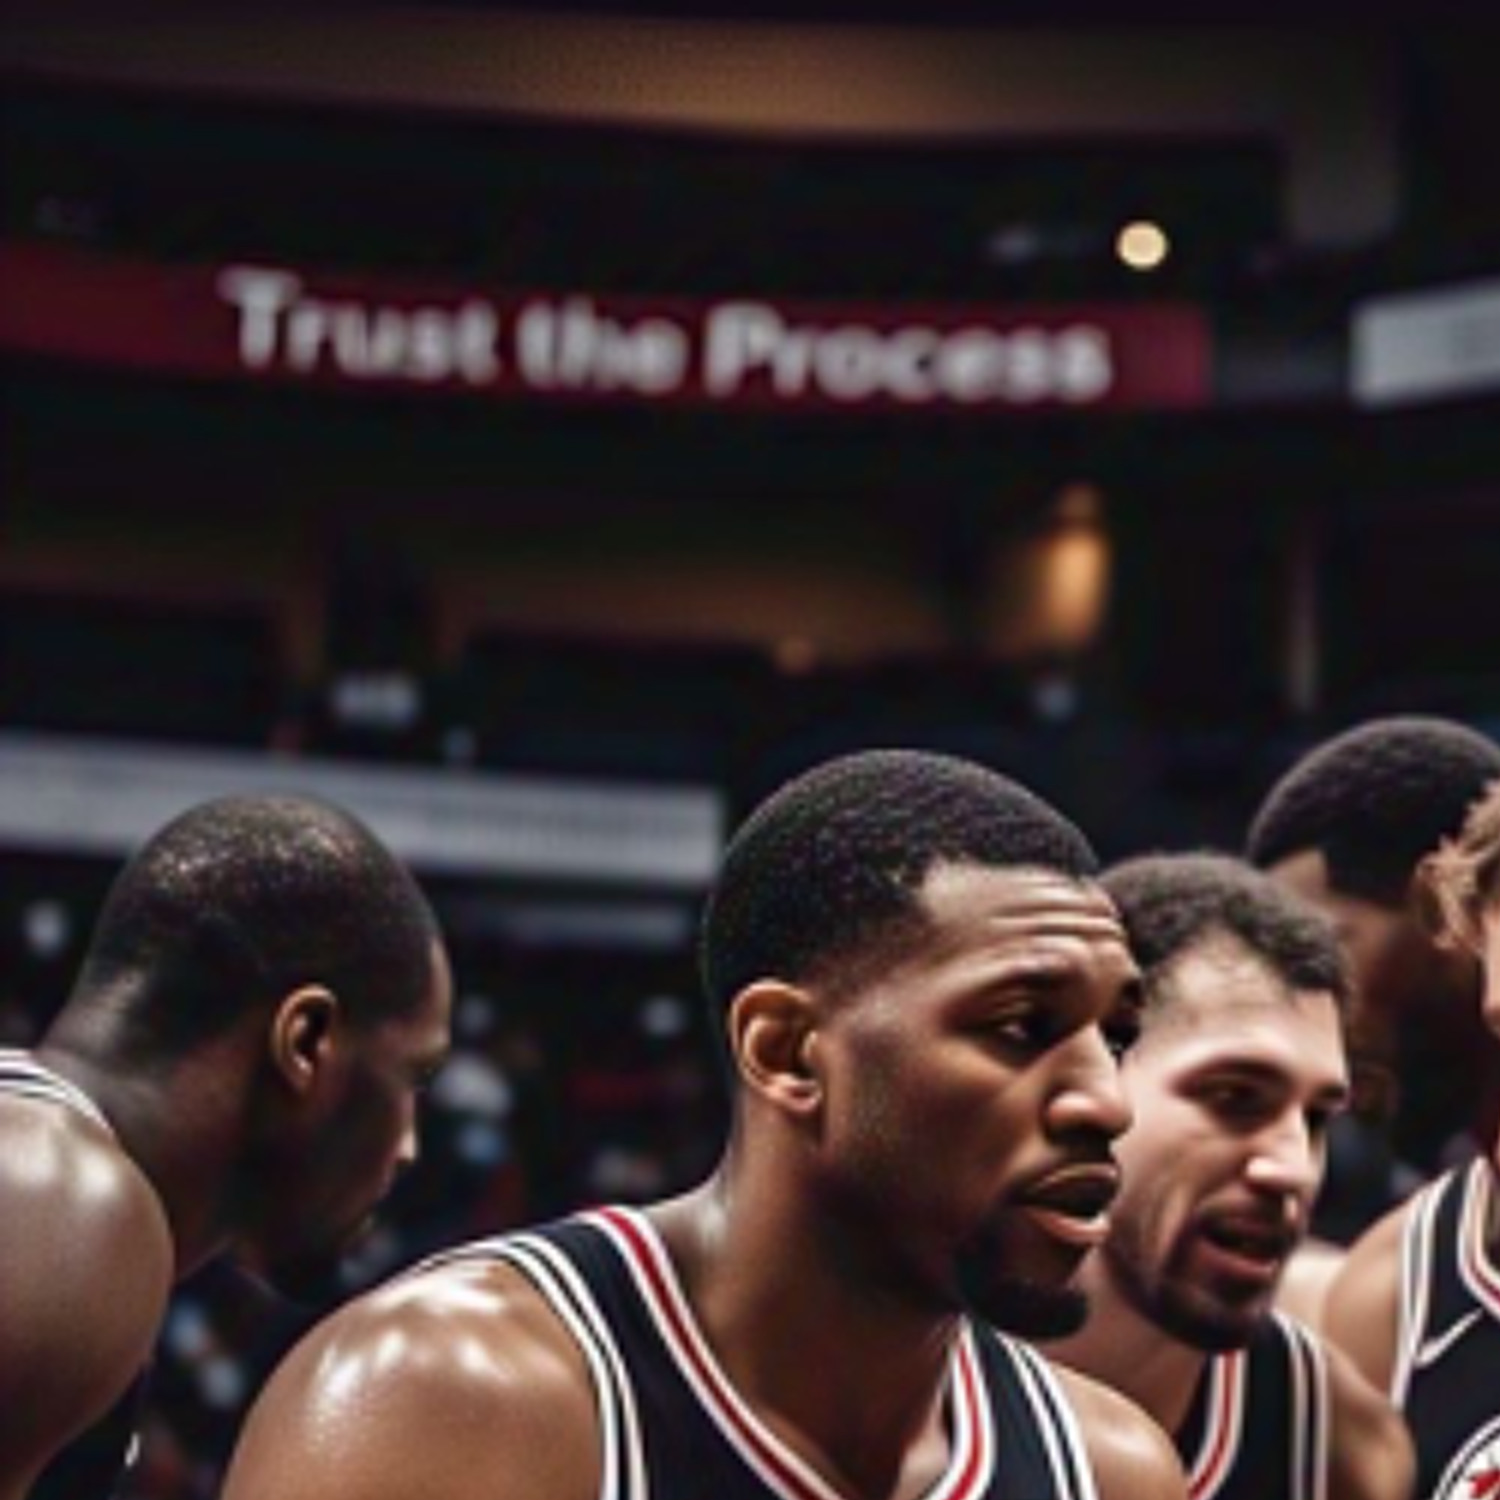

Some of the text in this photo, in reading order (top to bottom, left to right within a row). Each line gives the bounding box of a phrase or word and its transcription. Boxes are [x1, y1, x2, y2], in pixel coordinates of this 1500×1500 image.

[217, 266, 1113, 402] Trust the Process
